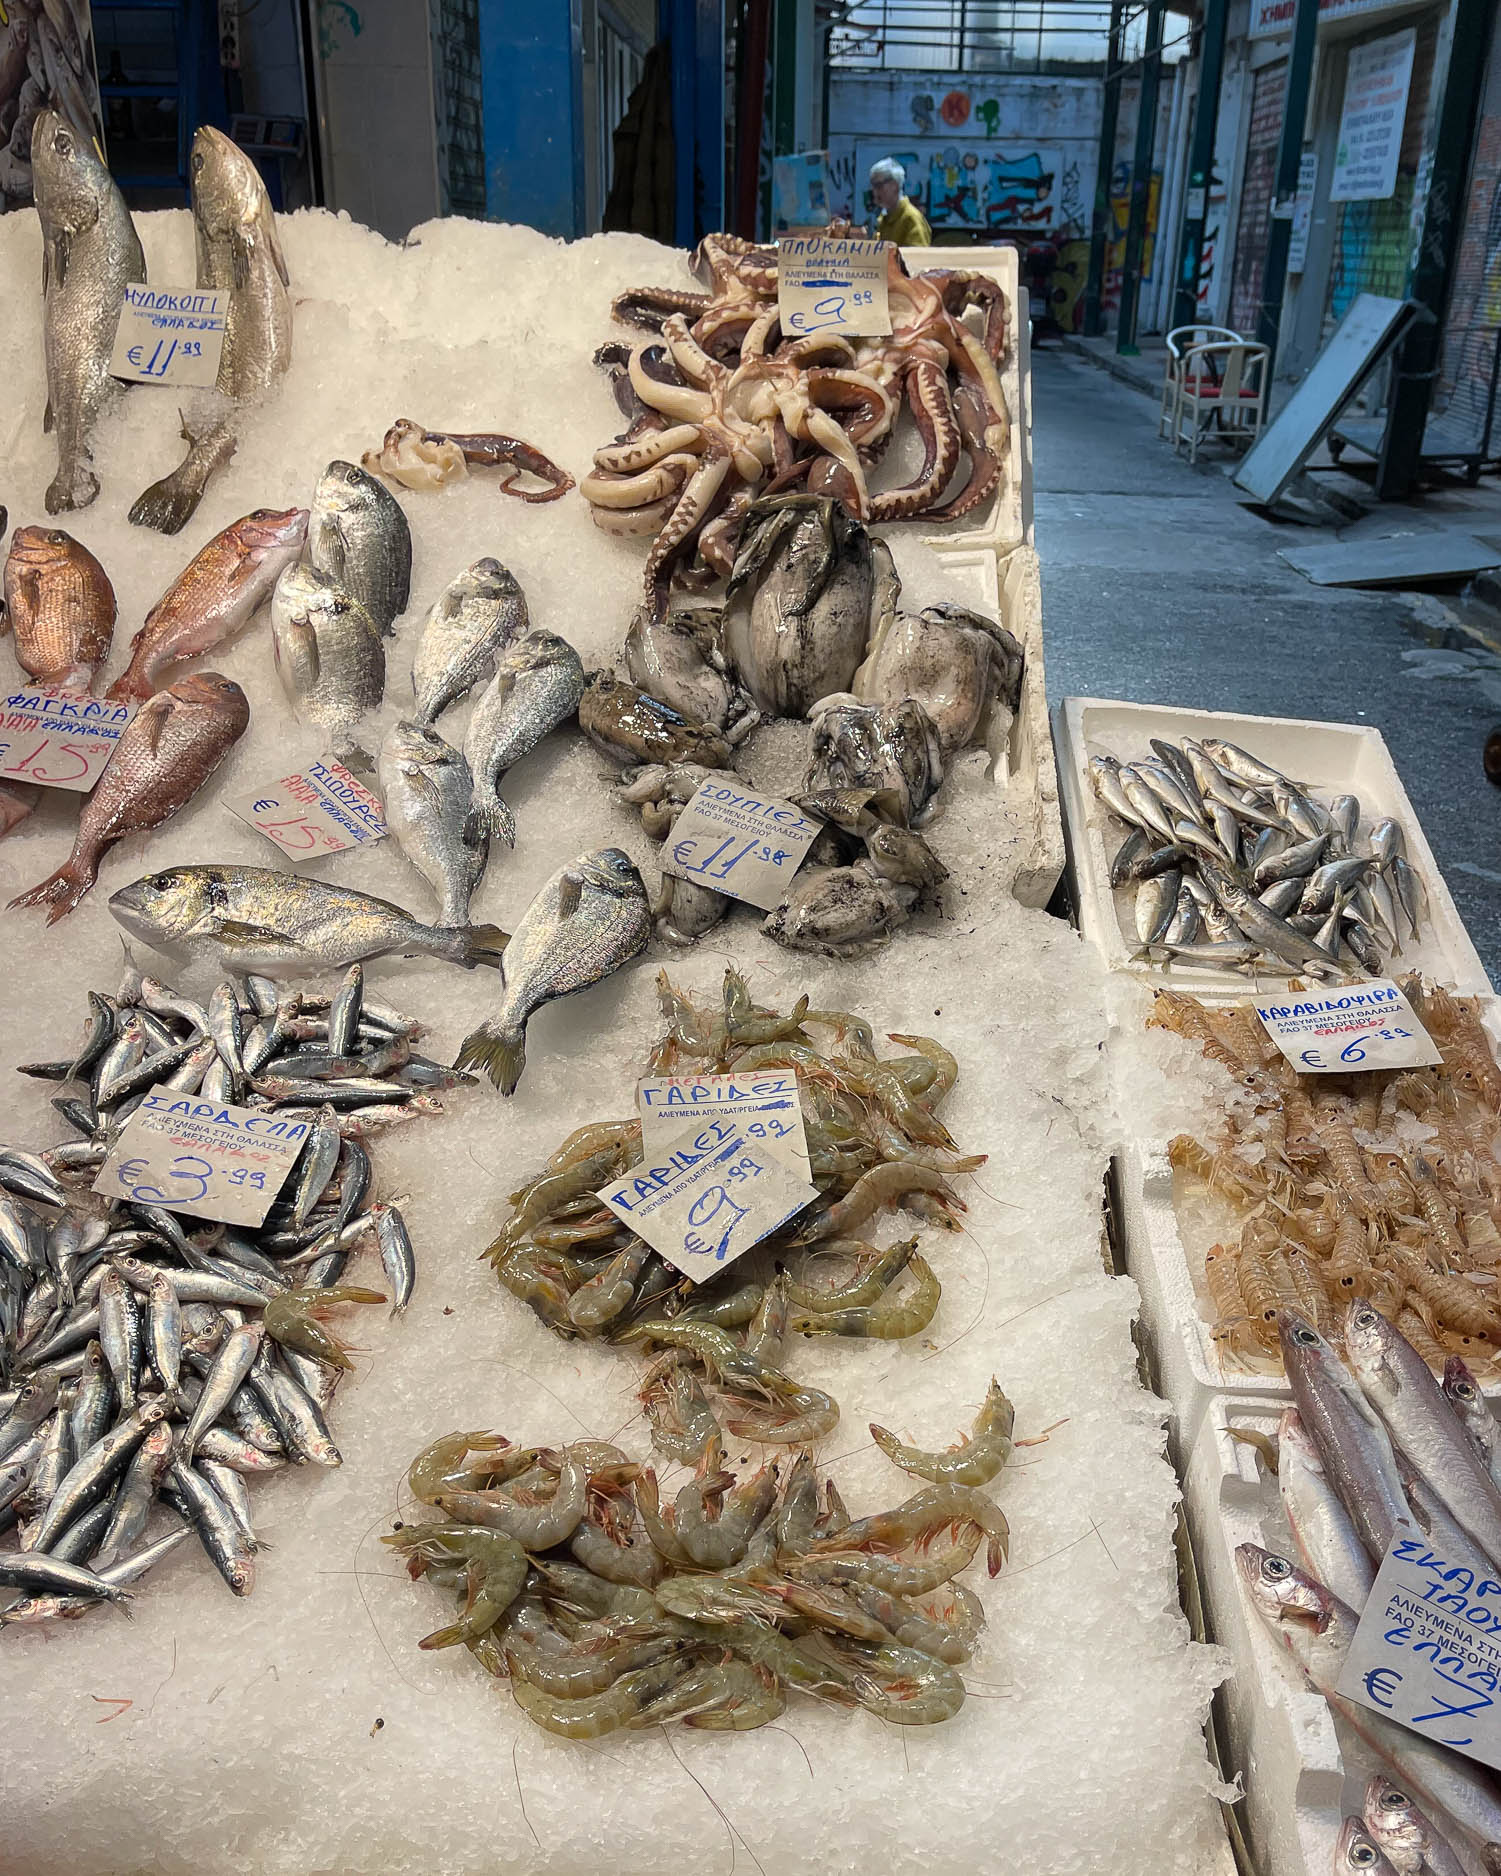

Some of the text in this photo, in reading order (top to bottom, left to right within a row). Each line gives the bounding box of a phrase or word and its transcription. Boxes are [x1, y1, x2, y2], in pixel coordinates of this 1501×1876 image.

[789, 312, 806, 330] €
[127, 345, 145, 367] €
[252, 799, 280, 813] €
[693, 806, 772, 838] FAO 37 ΜΕΣΟΓΕΙΟΥ
[698, 799, 804, 842] ΑΛΙΕΥΜΕΝΑ ΣΤΗ ΘΑΛΑΣΣΑ
[700, 784, 813, 833] ΣΟΥΠΙΕΣ
[672, 840, 698, 866] €
[1256, 987, 1399, 1022] ΚΑΡΑΒΙΔΟΨΙΡΑ
[1276, 1004, 1404, 1028] ΑΛΙΕΥΜΕΝΑ ΣΤΗ ΘΑΛΑΣΣΑ
[1279, 1017, 1371, 1034] FAO 37 ΜΕΣΟΓΕΙΟΥ
[1299, 1050, 1328, 1068] €
[643, 1080, 798, 1105] ΓΑΡΙΔΕΣ
[142, 1095, 308, 1141] ΣΑΡΔΕΛΑ
[658, 1109, 701, 1118] ΑΛΙΕΥΜΕΝΑ
[140, 1119, 246, 1151] FAO 37 ΜΕΣΟΓΕΙΟΥ
[145, 1112, 288, 1154] ΑΛΙΕΥΜΕΝΑ ΣΤΗ ΘΑΛΑΣΣΑ
[117, 1158, 150, 1187] €
[610, 1120, 737, 1211] ΓΑΡΙΔΕΣ
[638, 1191, 673, 1218] ΑΛΙΕΥΜΕΝΑ
[672, 1180, 689, 1195] ΑΠΟ
[684, 1231, 715, 1254] €
[1384, 1606, 1415, 1629] FAO
[1417, 1624, 1434, 1639] 37
[1390, 1594, 1473, 1647] ΑΛΙΕΥΜΕΝΑ
[1384, 1627, 1501, 1692] ΕΛΛΑ
[1362, 1667, 1403, 1709] €
